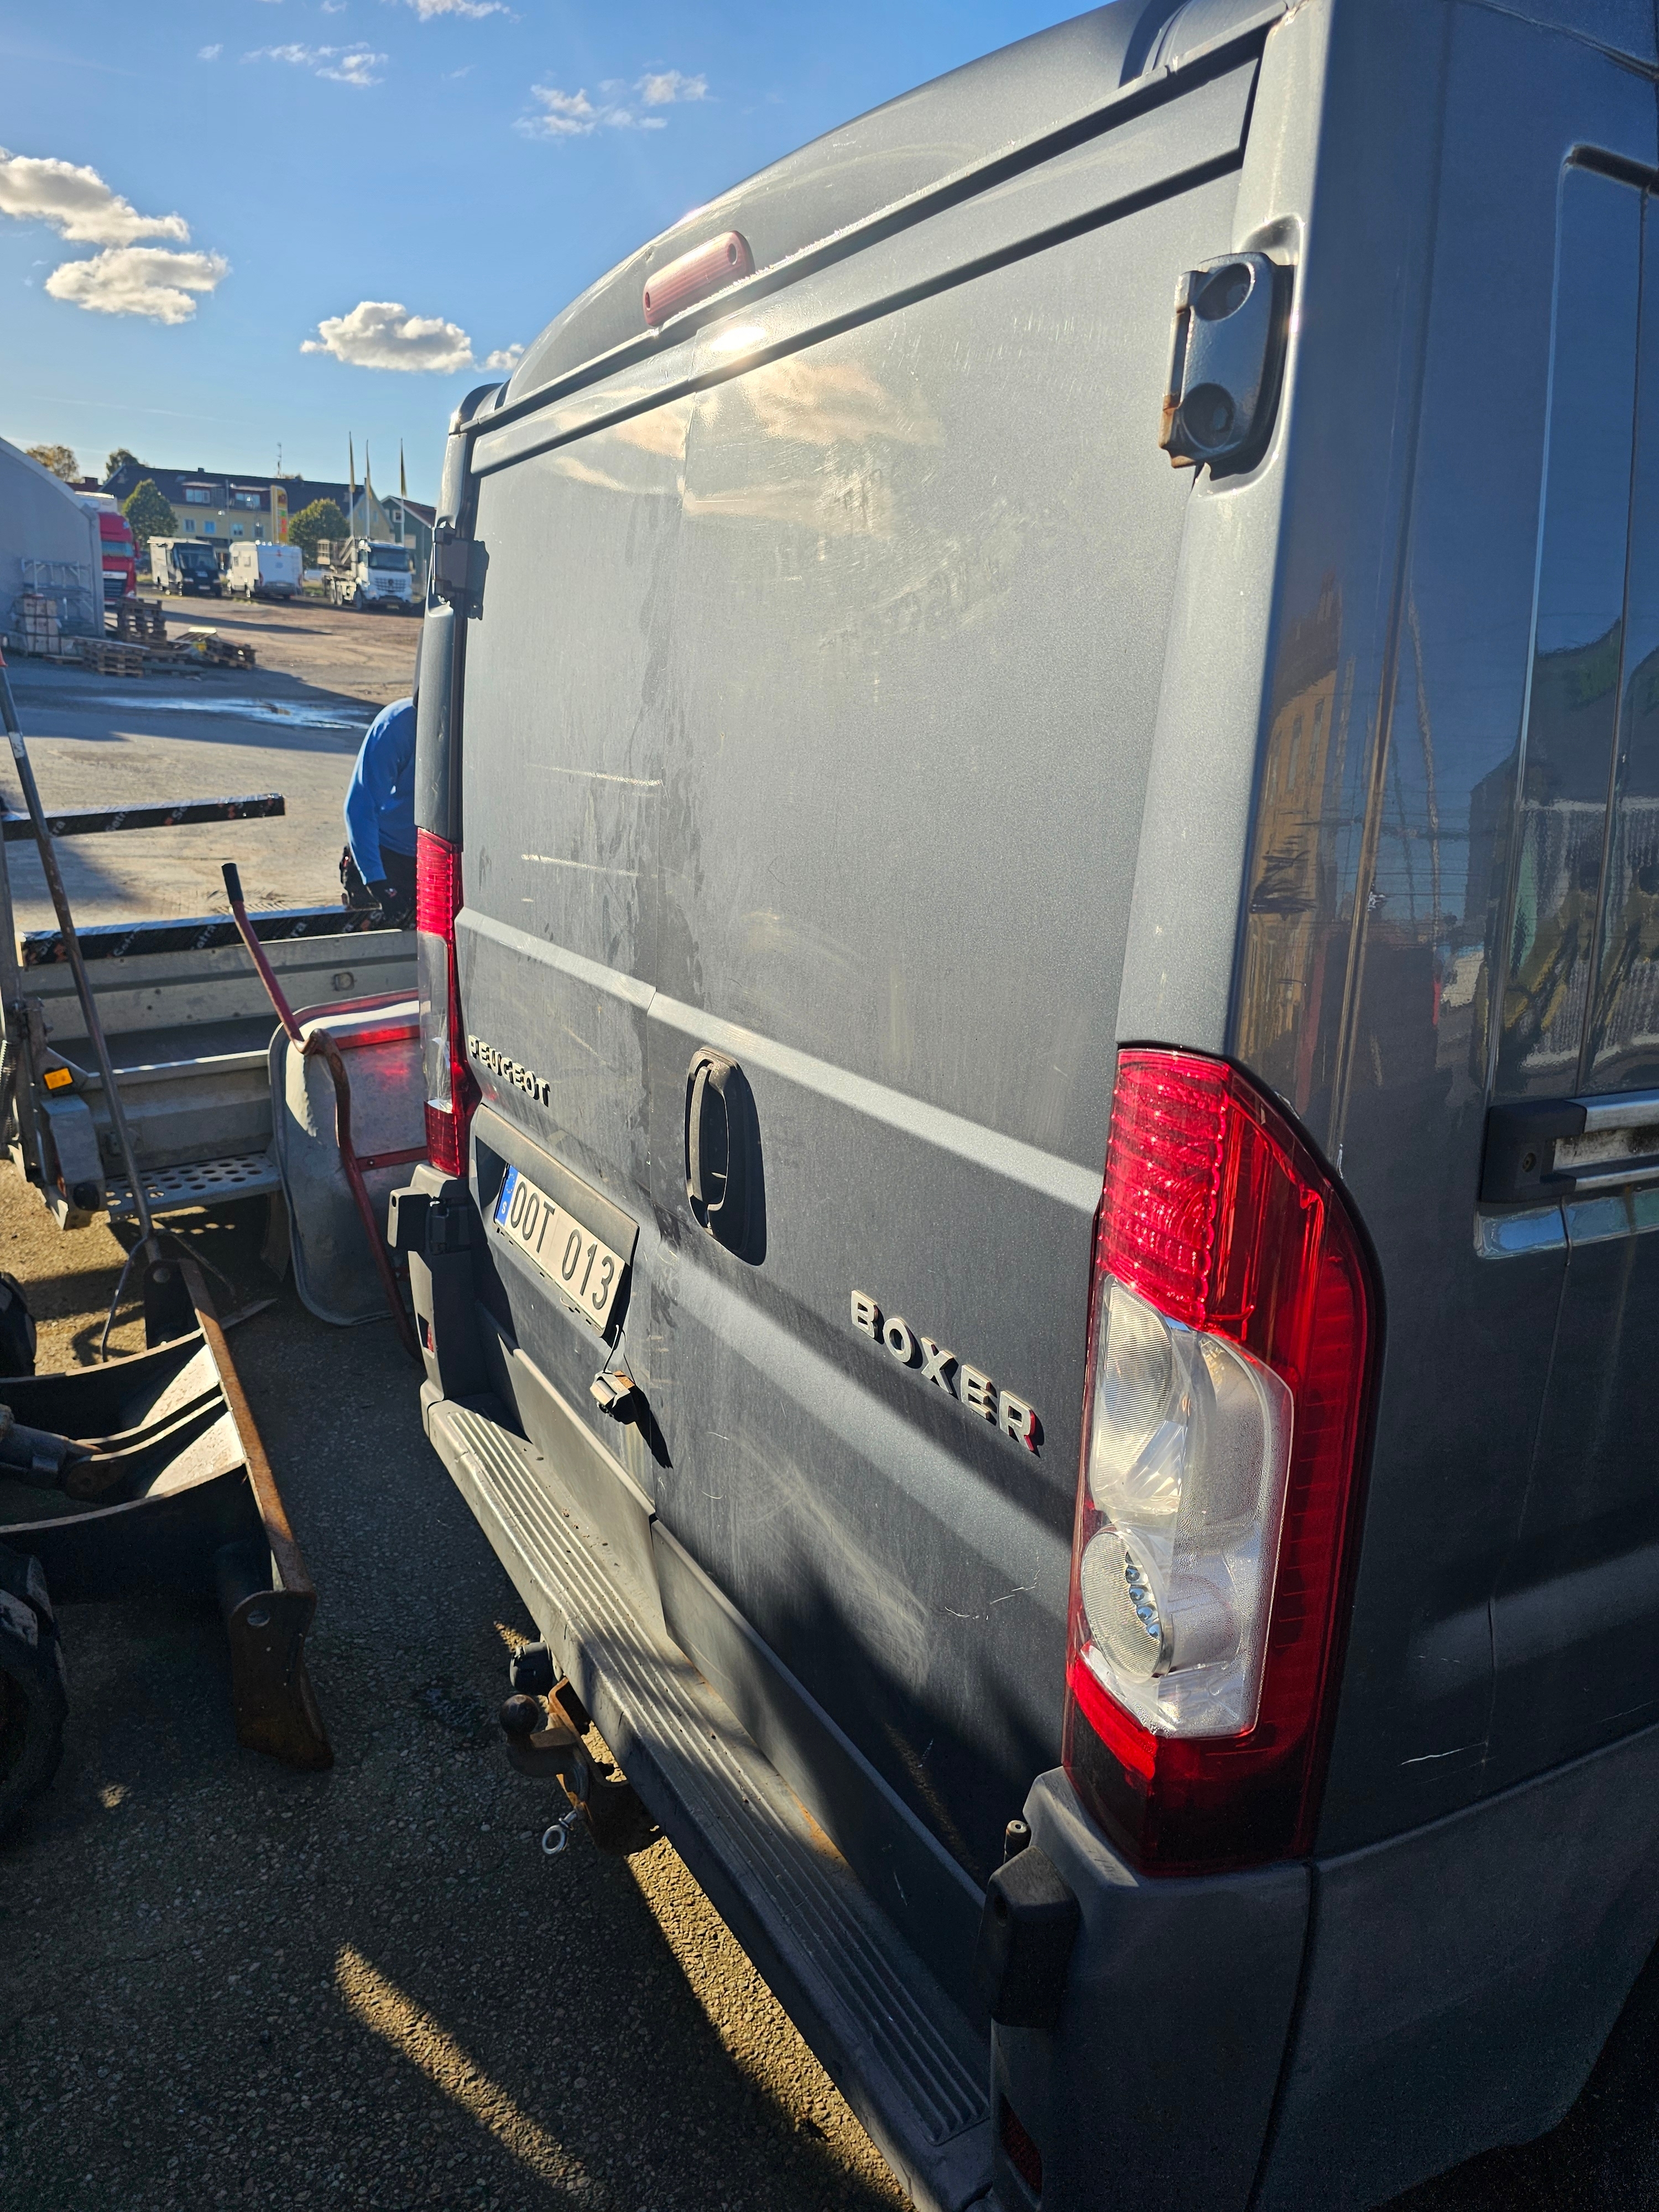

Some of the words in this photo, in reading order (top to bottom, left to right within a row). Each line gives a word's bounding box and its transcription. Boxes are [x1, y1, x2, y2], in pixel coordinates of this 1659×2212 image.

[467, 1035, 550, 1106] PEUGEOT
[501, 1201, 508, 1215] S
[561, 1227, 615, 1311] 013
[851, 1290, 1036, 1452] BOXER
